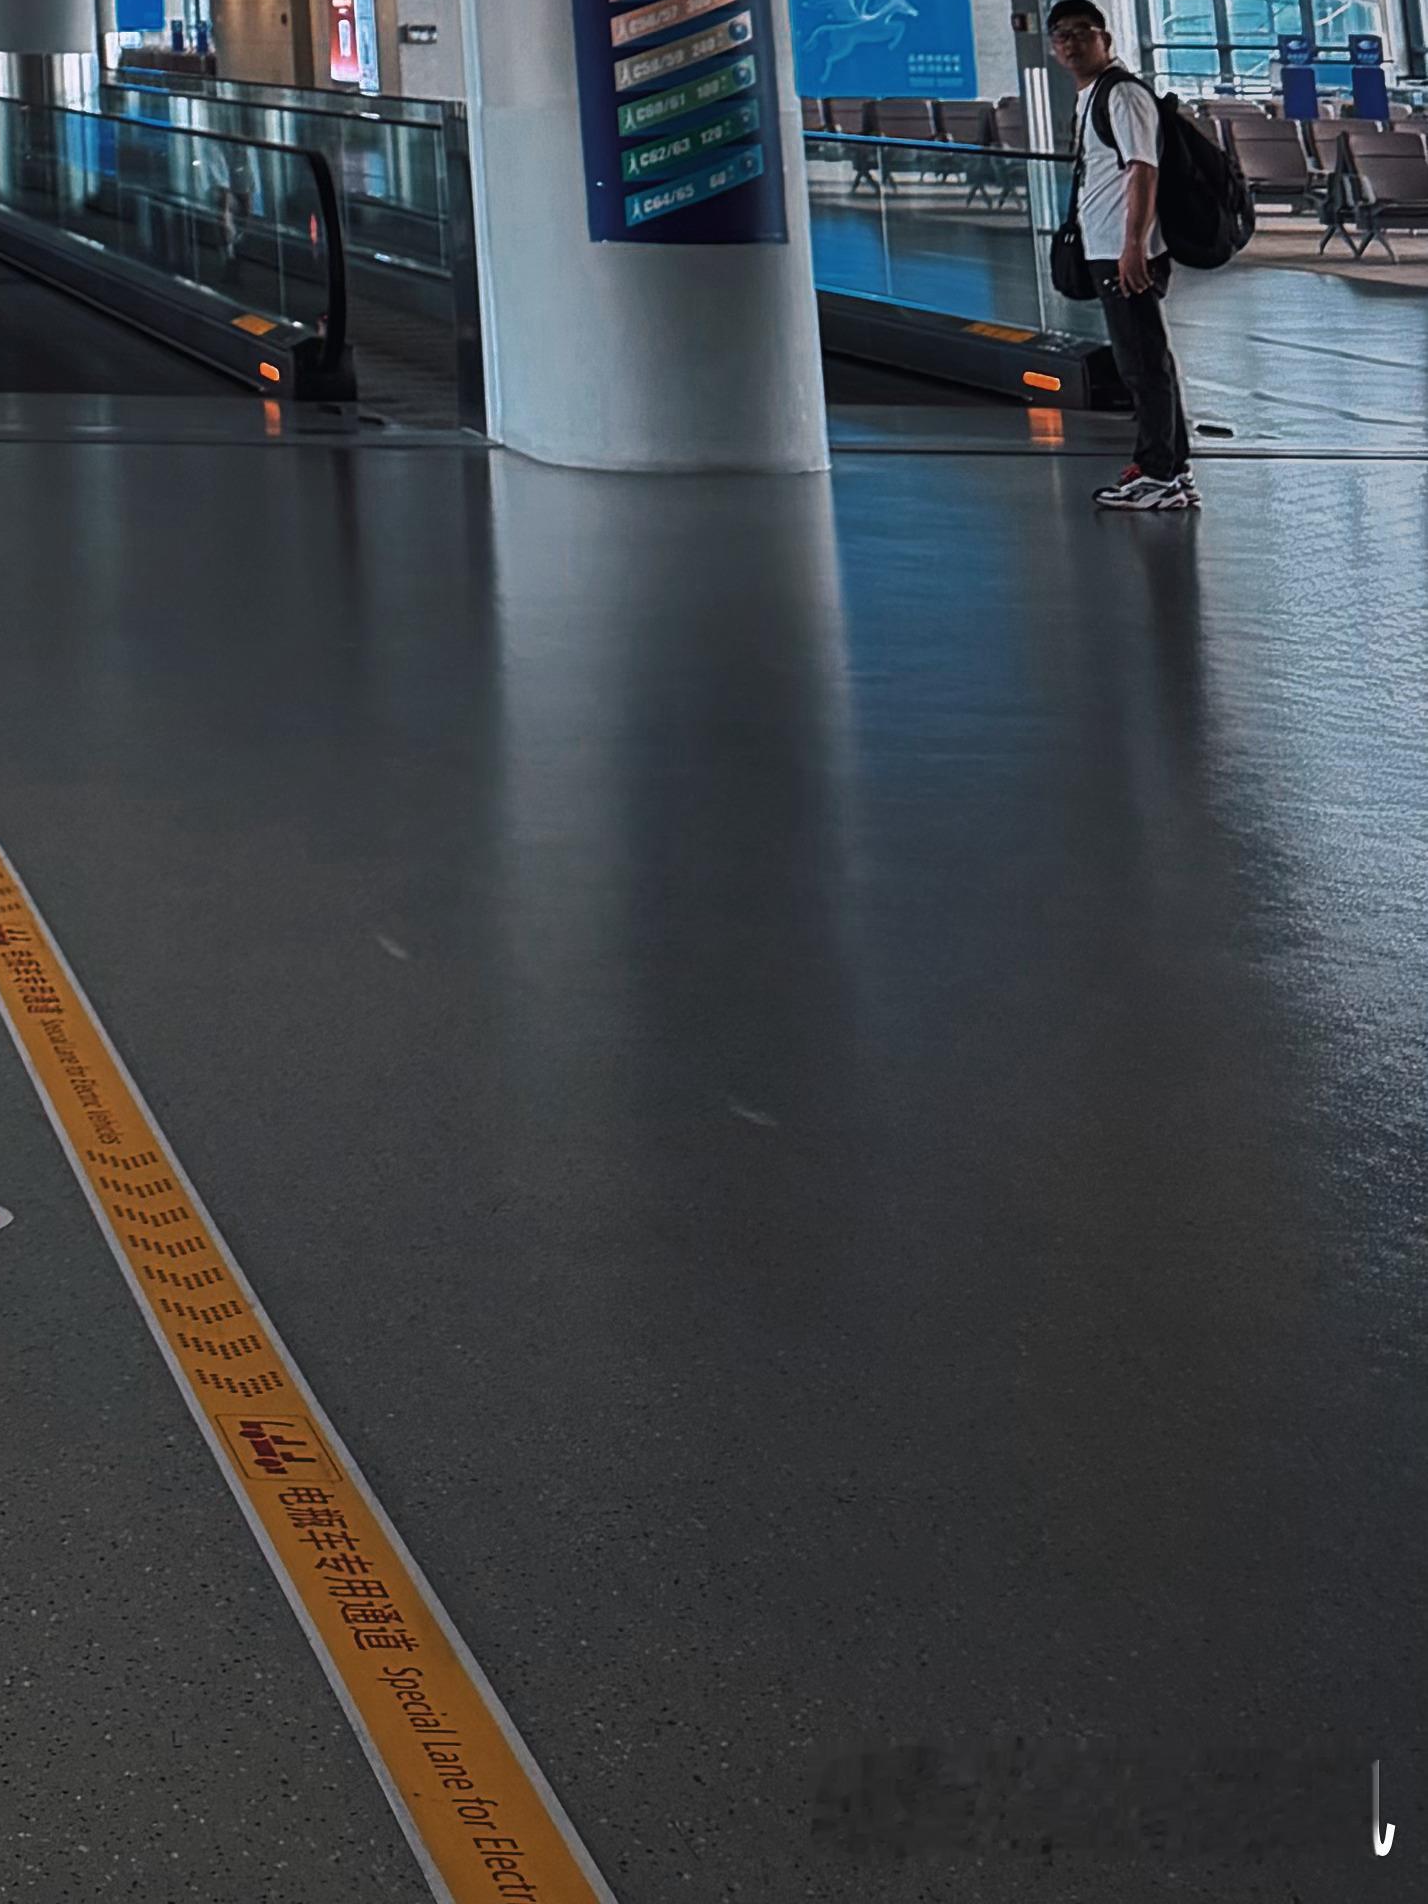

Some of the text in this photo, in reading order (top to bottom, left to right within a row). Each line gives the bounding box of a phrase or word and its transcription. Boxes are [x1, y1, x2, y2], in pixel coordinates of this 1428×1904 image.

[278, 1486, 419, 1652] 电瓶车专用通道
[376, 1666, 458, 1734] Special
[422, 1741, 474, 1791] Lane
[452, 1797, 499, 1830] for
